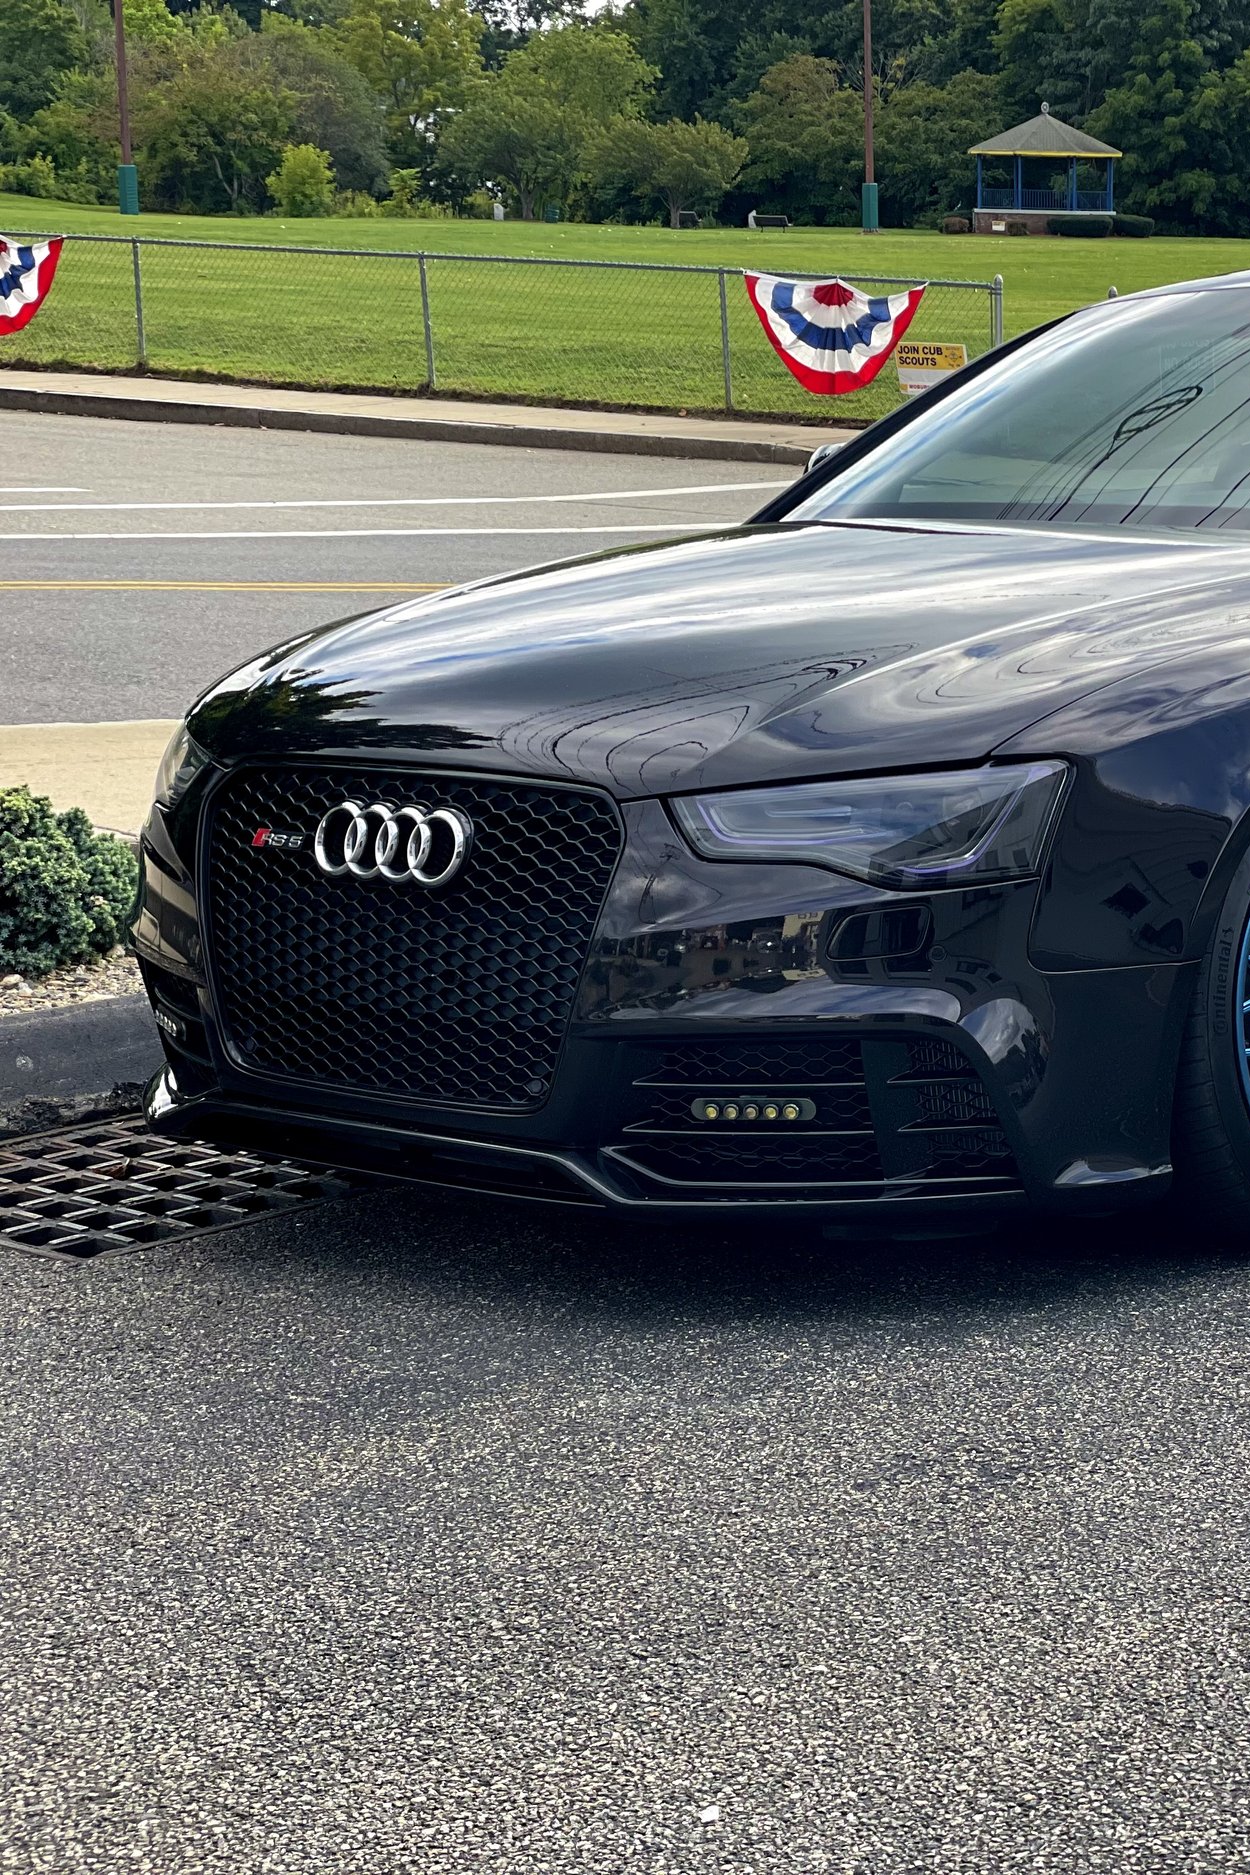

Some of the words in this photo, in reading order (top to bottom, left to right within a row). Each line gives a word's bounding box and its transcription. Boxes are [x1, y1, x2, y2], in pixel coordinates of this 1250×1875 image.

[898, 345, 919, 355] JOIN
[922, 346, 943, 356] CUB
[899, 356, 937, 366] SCOUTS
[1213, 939, 1232, 1034] Continental
